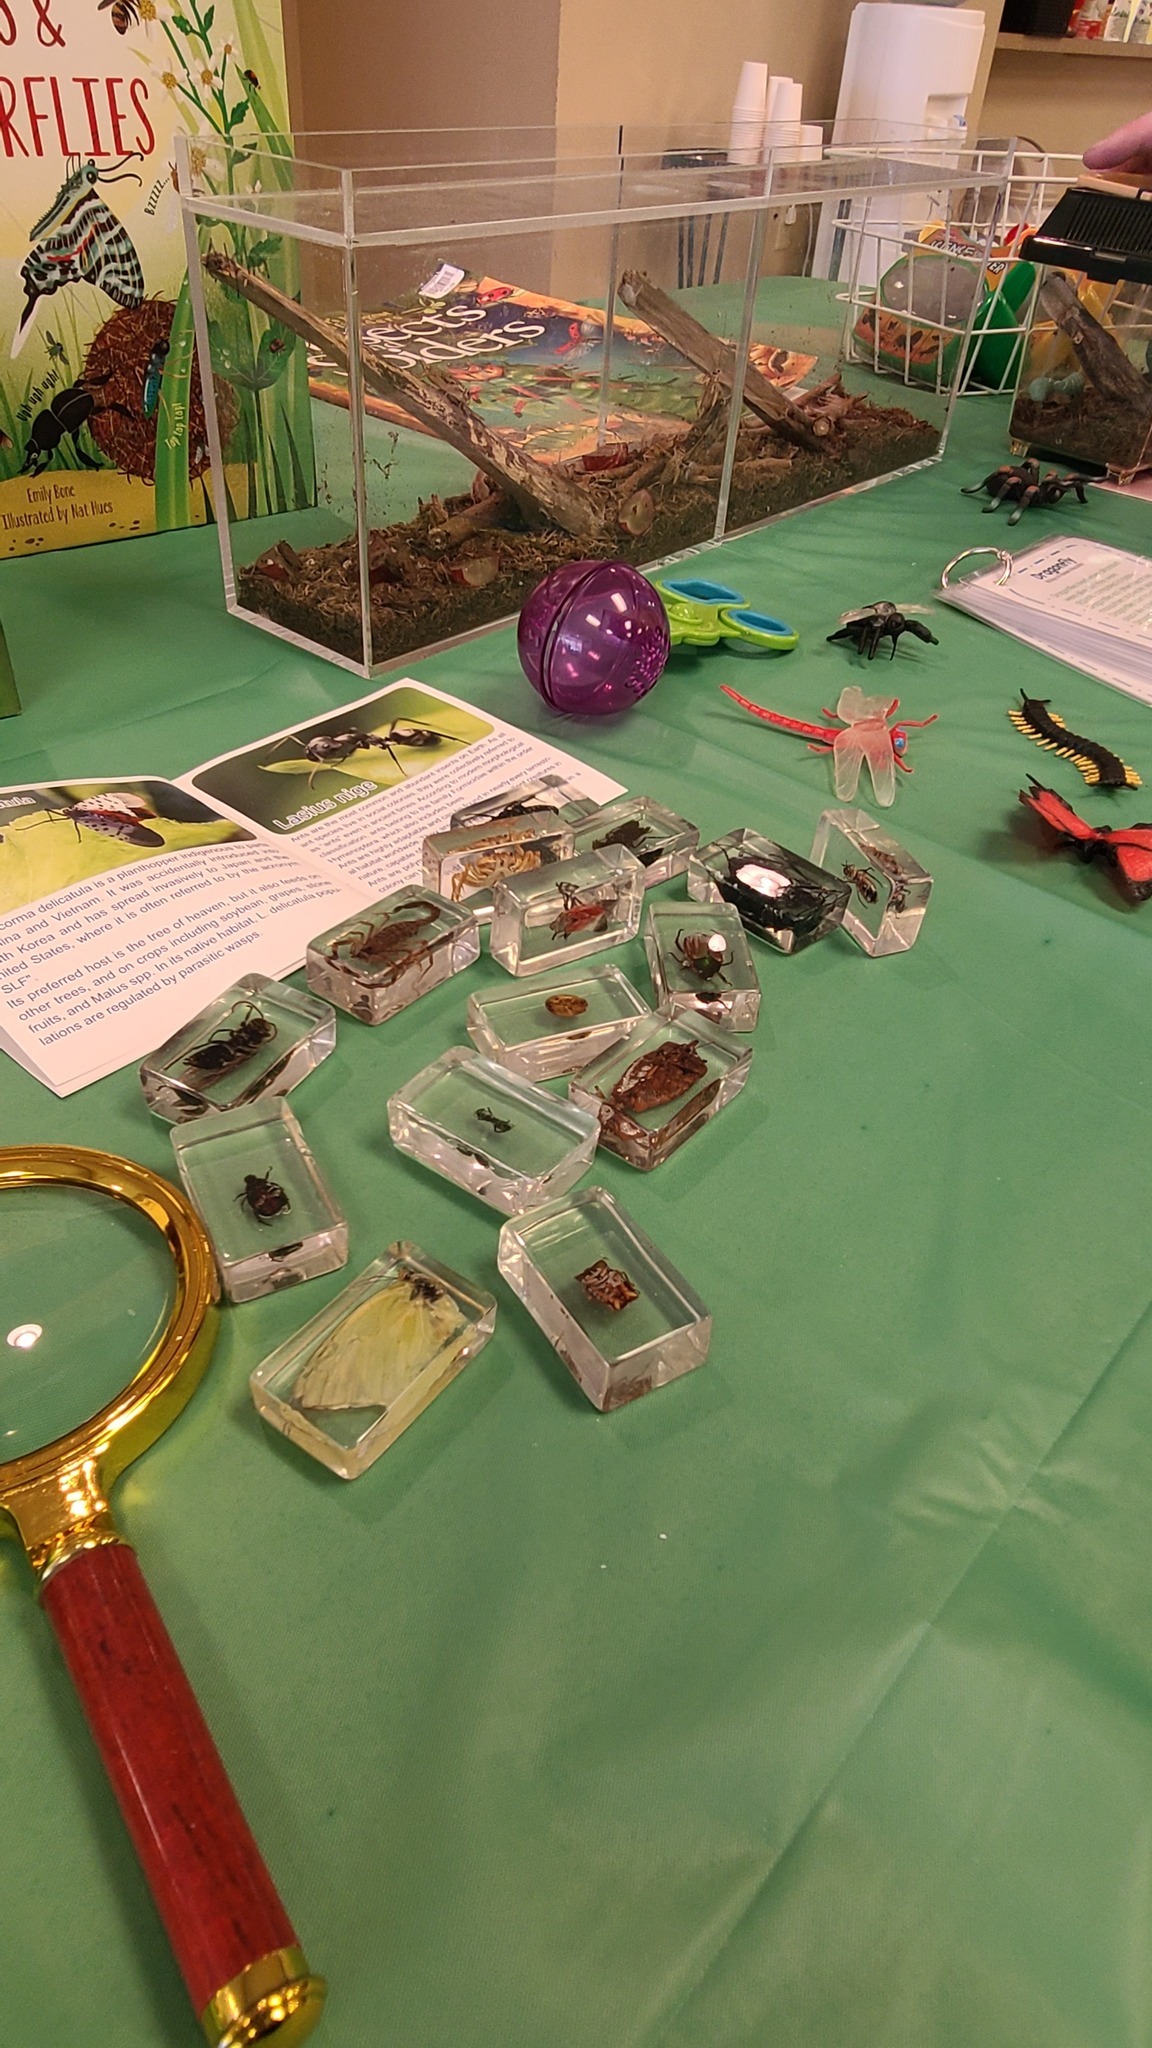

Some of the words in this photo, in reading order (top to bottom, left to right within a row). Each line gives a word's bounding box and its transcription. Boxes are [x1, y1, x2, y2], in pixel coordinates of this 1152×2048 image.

[16, 403, 33, 422] Ugh
[28, 386, 45, 405] ugh
[41, 368, 60, 389] ugh!
[171, 402, 186, 420] tap!
[165, 436, 181, 450] Tap
[173, 422, 187, 437] tap
[1, 505, 55, 530] Illustrated
[56, 505, 68, 525] by
[71, 503, 89, 519] Nat
[90, 500, 114, 517] Hues
[26, 485, 52, 504] Emily
[53, 484, 76, 500] Bone
[1030, 557, 1078, 580] Dragonfly
[272, 798, 337, 831] Lasius
[333, 780, 378, 804] nige
[16, 934, 56, 954] Korea
[59, 919, 82, 936] and
[83, 909, 108, 923] has
[110, 889, 150, 911] spread
[151, 870, 204, 893] invasively
[221, 860, 250, 870] Japan
[25, 918, 49, 935] and
[50, 897, 104, 921] Vietnam.
[105, 888, 117, 897] It
[118, 879, 143, 892] was
[146, 859, 207, 882] accidentally
[209, 847, 259, 862] introduced
[37, 885, 93, 913] delicatula
[93, 880, 105, 889] is
[106, 876, 116, 884] a
[116, 856, 179, 881] planthopper
[30, 943, 75, 964] States,
[76, 923, 113, 943] where
[113, 916, 125, 925] it
[124, 911, 138, 920] is
[139, 897, 169, 913] often
[169, 879, 212, 900] referred
[225, 871, 241, 879] by
[6, 997, 25, 1009] Its
[26, 968, 84, 1002] preferred
[83, 955, 112, 973] host
[112, 950, 126, 960] is
[125, 939, 146, 952] the
[146, 927, 171, 942] tree
[172, 918, 185, 929] of
[184, 901, 230, 923] heaven,
[228, 891, 249, 903] but
[258, 882, 280, 892] also
[18, 1001, 51, 1021] other
[53, 985, 92, 1004] trees,
[92, 970, 116, 987] and
[118, 963, 135, 974] on
[136, 945, 169, 965] crops
[168, 919, 220, 948] including
[27, 1014, 67, 1034] fruits,
[66, 999, 91, 1016] and
[90, 982, 129, 1004] Malus
[129, 971, 156, 986] spp.
[154, 962, 169, 971] In
[167, 954, 184, 965] its
[183, 936, 218, 957] native
[216, 917, 258, 940] habitat,
[269, 893, 316, 914] delicatula
[38, 1022, 83, 1045] lations
[83, 1011, 105, 1025] are
[105, 981, 162, 1015] regulated
[160, 974, 177, 986] by
[178, 949, 225, 979] parasitic
[224, 931, 262, 952] wasps.
